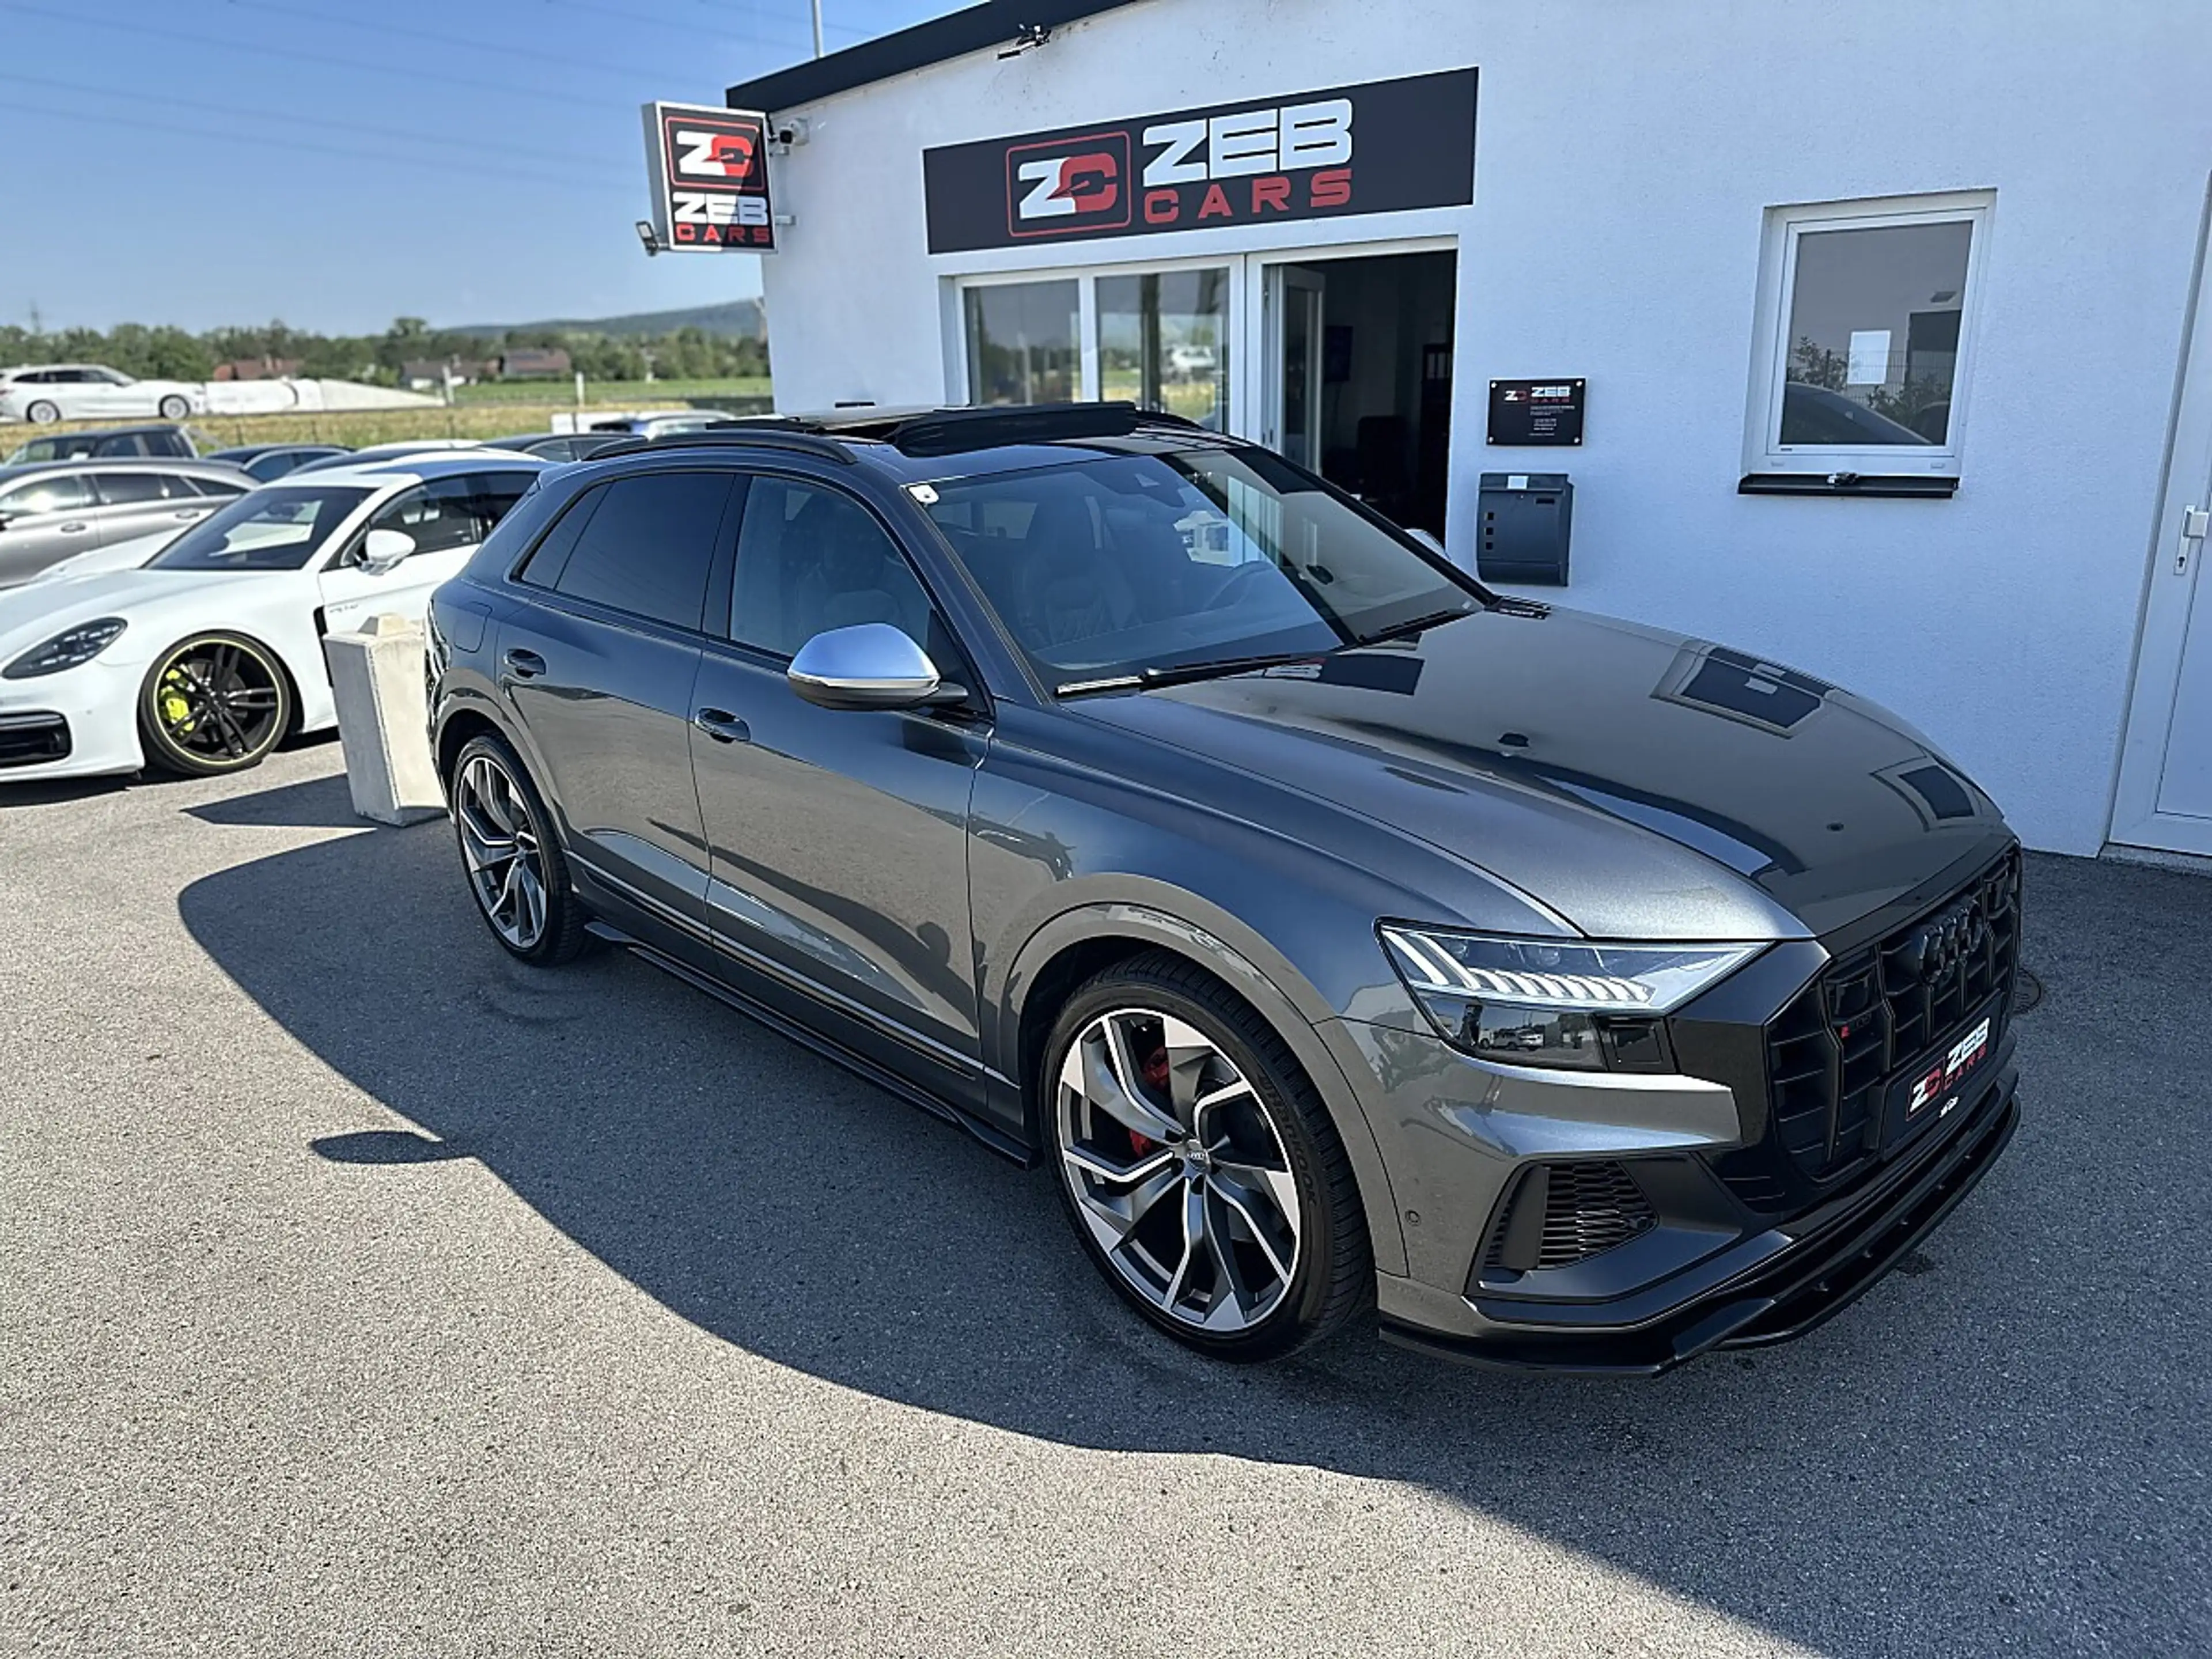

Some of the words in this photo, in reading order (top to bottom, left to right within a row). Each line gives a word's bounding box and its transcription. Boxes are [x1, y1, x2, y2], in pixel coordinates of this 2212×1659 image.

[1143, 98, 1353, 187] ZEB
[672, 191, 768, 225] ZEB
[1144, 168, 1352, 224] CARS
[676, 222, 770, 243] CARS
[1531, 385, 1571, 397] ZEB
[1944, 1043, 1987, 1090] CARS
[1945, 1017, 1990, 1077] ZEB
